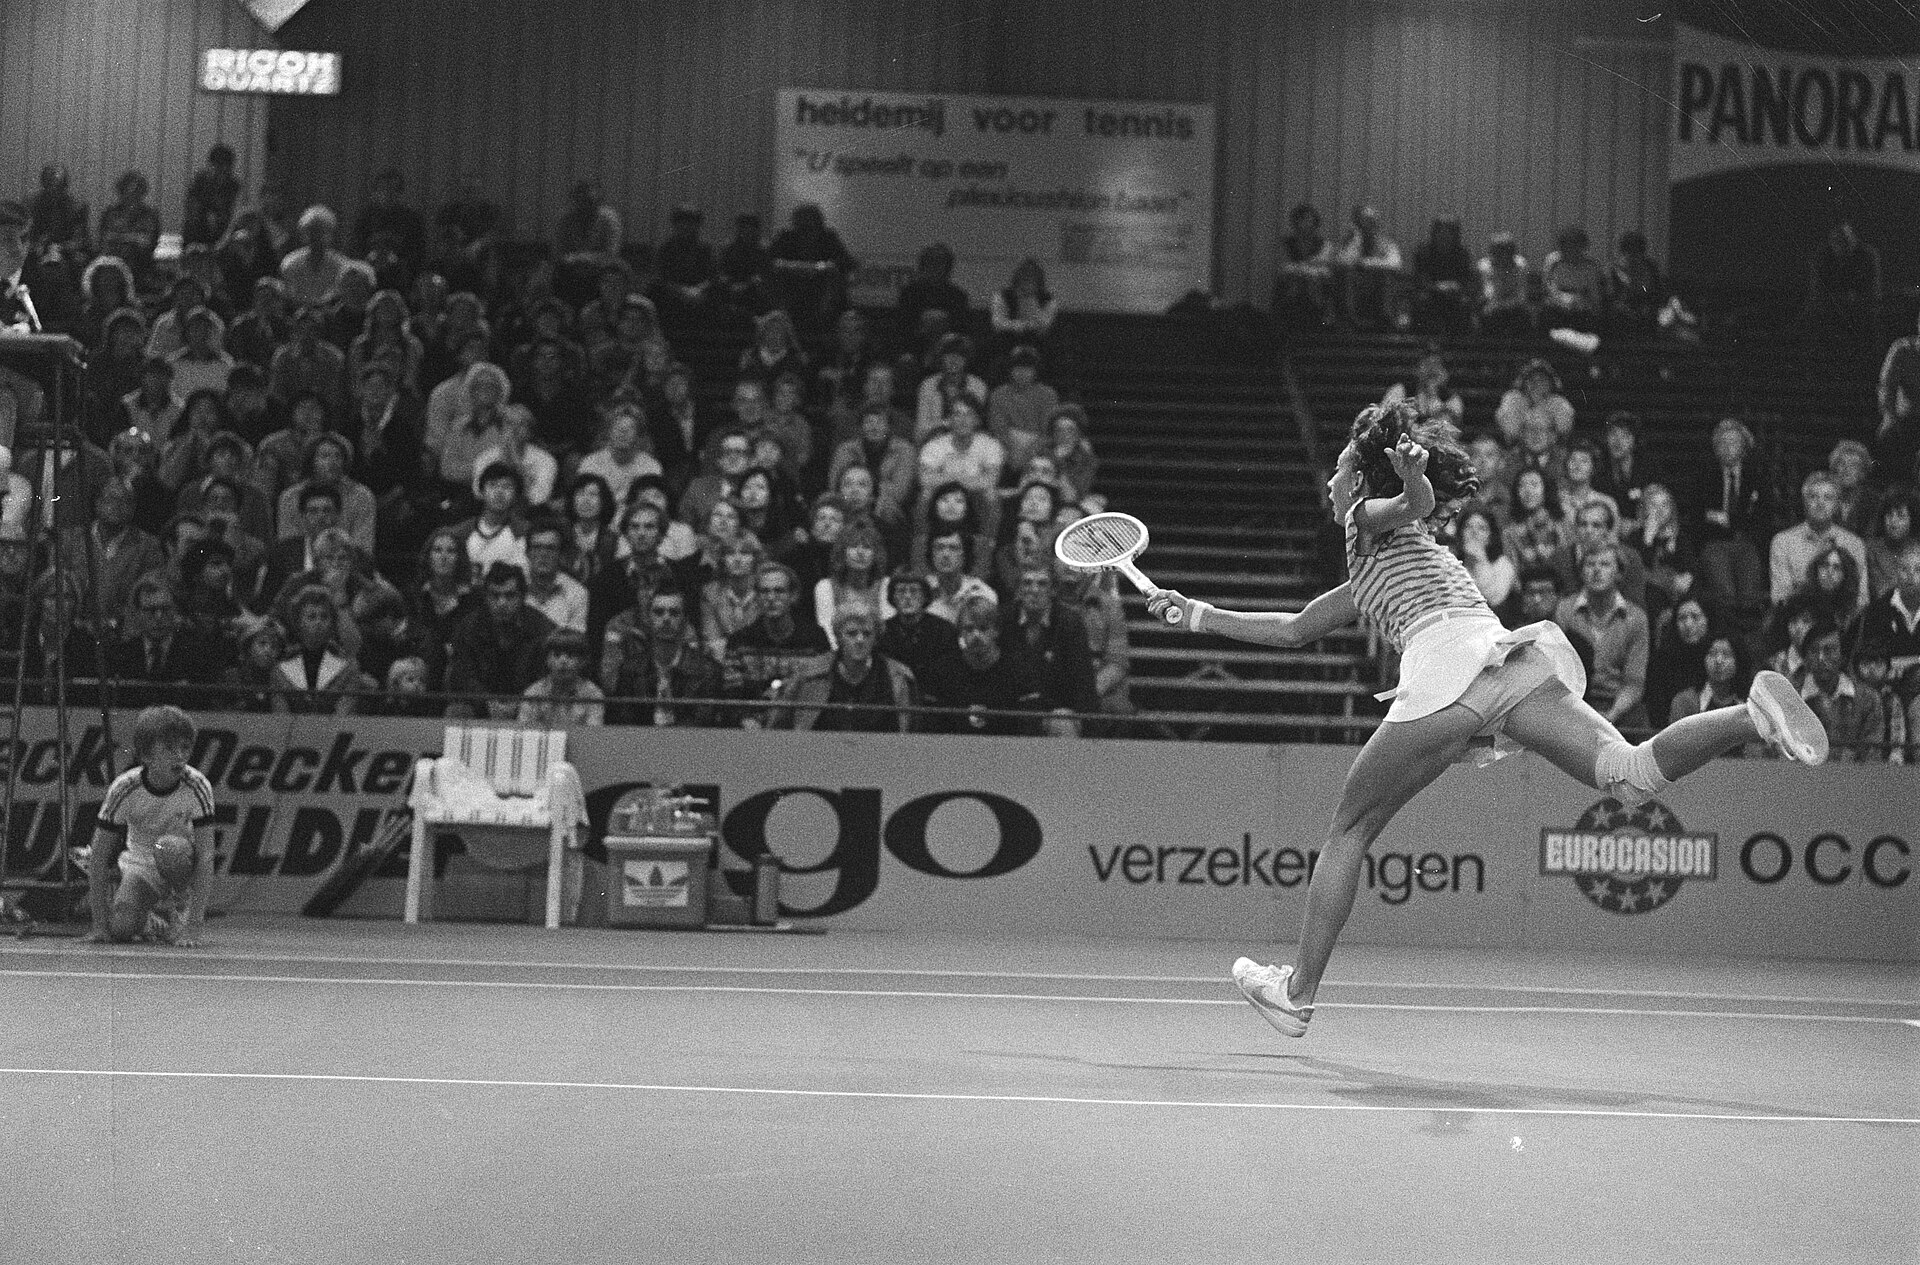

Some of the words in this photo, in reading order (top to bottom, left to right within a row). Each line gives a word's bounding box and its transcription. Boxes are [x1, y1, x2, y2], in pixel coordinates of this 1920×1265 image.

[972, 108, 1058, 135] voor
[1084, 108, 1195, 140] tennis
[1679, 62, 1920, 150] PANORA
[190, 727, 443, 796] Decke
